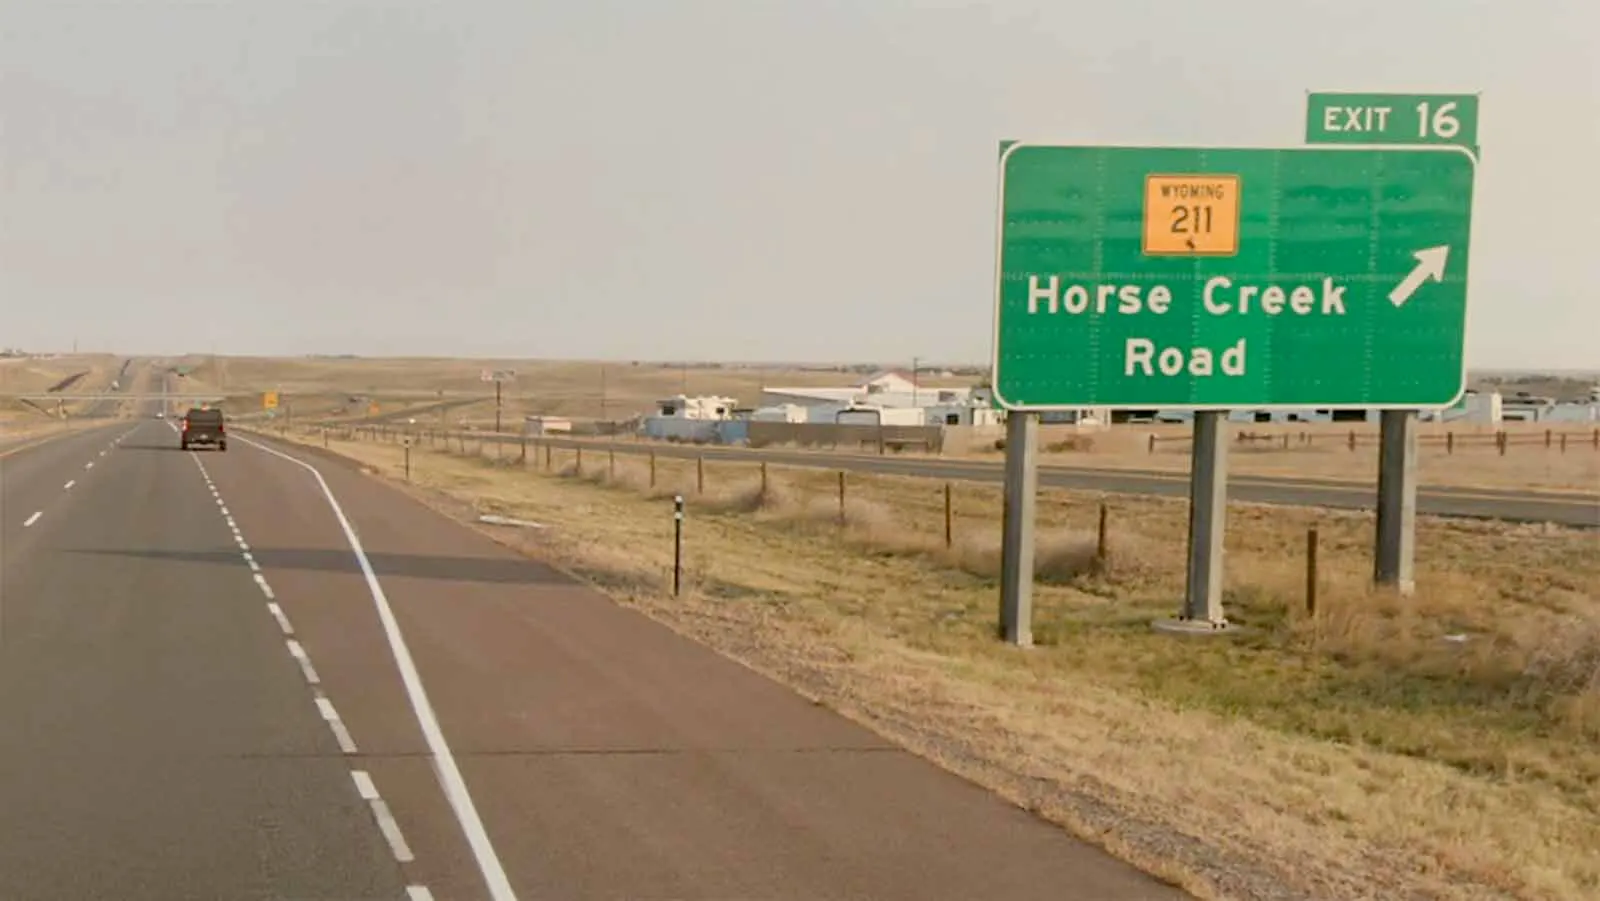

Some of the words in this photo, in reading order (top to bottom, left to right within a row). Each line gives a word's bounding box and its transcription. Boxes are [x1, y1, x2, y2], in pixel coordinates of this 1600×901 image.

[1323, 106, 1392, 132] EXIT
[1416, 102, 1460, 138] 16
[1161, 183, 1225, 200] WYOMING
[1170, 205, 1213, 234] 211
[1027, 276, 1172, 315] Horse
[1202, 276, 1347, 315] Creek
[1124, 338, 1247, 377] Road
